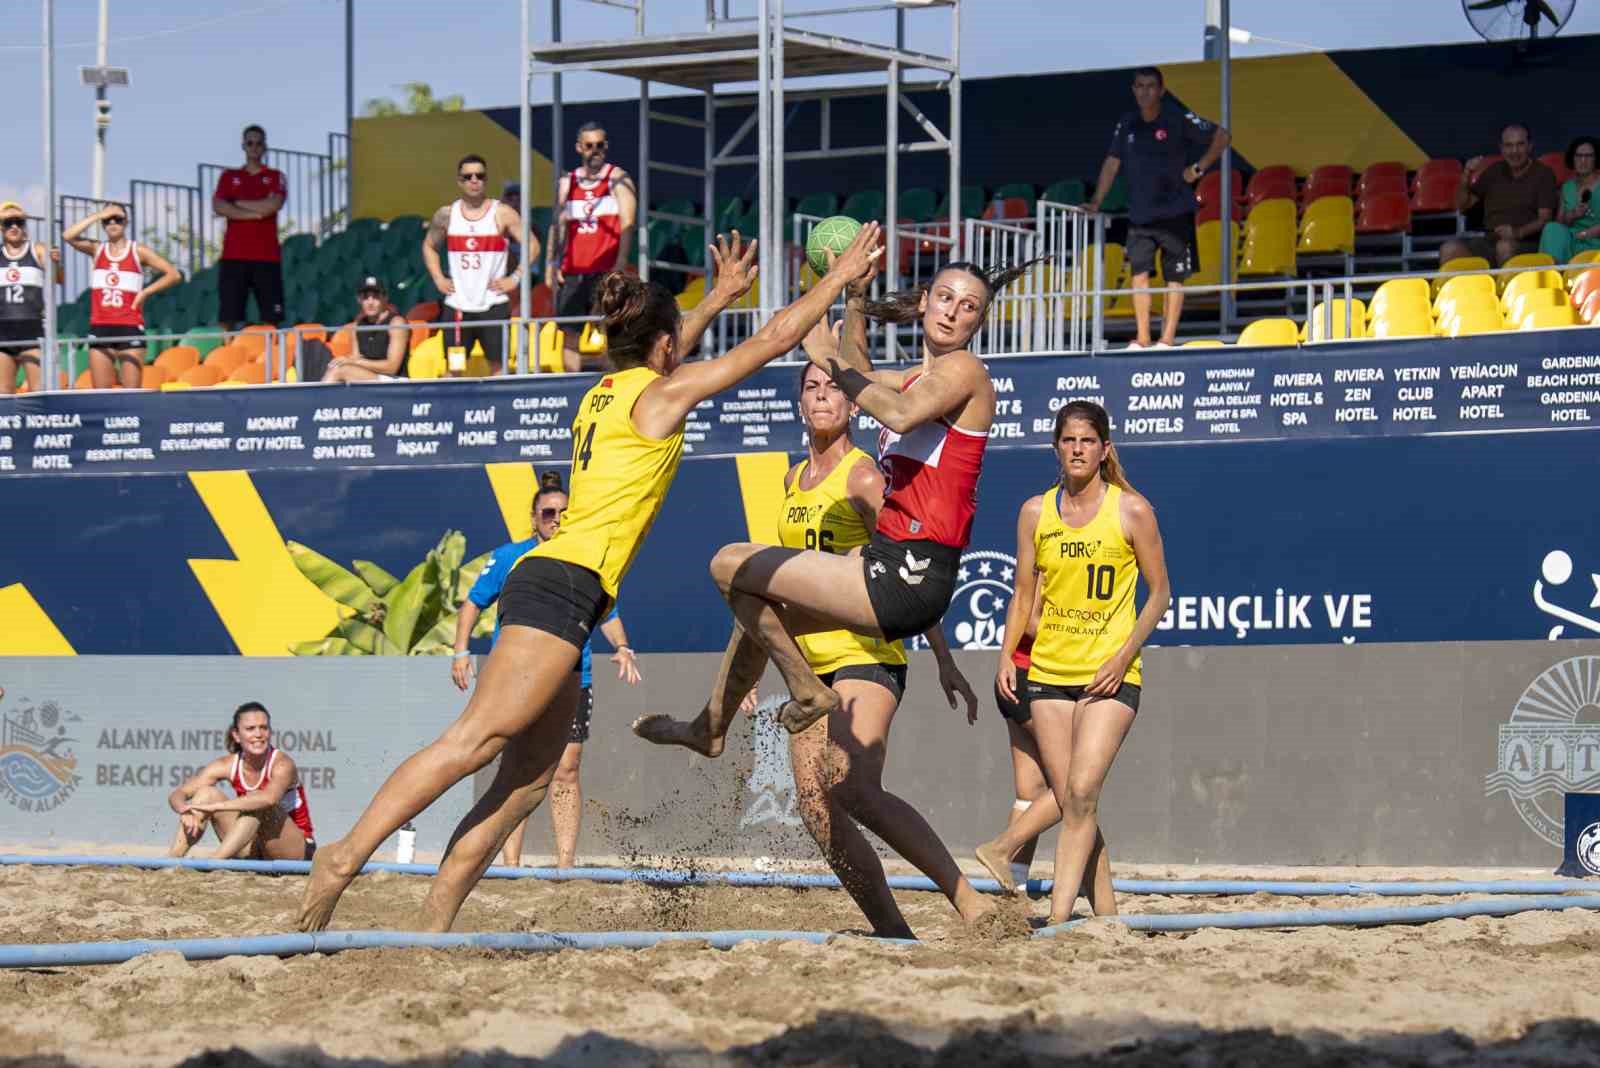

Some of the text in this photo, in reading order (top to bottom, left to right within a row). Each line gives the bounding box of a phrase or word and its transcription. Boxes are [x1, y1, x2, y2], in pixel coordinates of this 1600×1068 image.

[460, 253, 482, 271] 53
[5, 286, 25, 304] 12
[101, 290, 124, 309] 26
[1541, 355, 1600, 370] GARDENIA
[1131, 371, 1185, 388] GRAND
[1206, 368, 1255, 380] WYNDHAM
[1273, 373, 1323, 387] RIVIERA
[1334, 368, 1384, 382] RIVIERA
[1394, 367, 1441, 382] YETKIN
[1057, 376, 1100, 390] ROYAL
[1208, 382, 1244, 393] ALANYA
[1527, 375, 1568, 388] BEACH
[1344, 388, 1371, 402] ZEN
[1398, 387, 1434, 401] CLUB
[1461, 384, 1504, 399] APART
[1540, 390, 1600, 404] GARDENIA
[513, 396, 568, 410] CLUB AQUA
[1128, 394, 1184, 411] ZAMAN
[1193, 395, 1262, 407] AZURA DELUXE
[1270, 392, 1323, 407] HOTEL &
[313, 406, 383, 422] ASIA BEACH
[1195, 409, 1230, 420] RESORT
[1240, 408, 1257, 419] SPA
[1282, 412, 1307, 426] SPA
[1335, 407, 1379, 422] HOTEL
[1392, 407, 1437, 421] HOTEL
[1460, 405, 1504, 419] HOTEL
[1551, 409, 1590, 421] HOTEL
[26, 414, 82, 428] NOVELLA
[169, 422, 224, 434] BEST HOME
[247, 416, 298, 431] MONART
[1125, 417, 1184, 434] HOTELS
[318, 426, 363, 440] RESORT
[385, 422, 453, 436] ALPARSLAN
[540, 428, 572, 440] PLAZA
[988, 422, 1025, 438] OTEL
[1210, 423, 1240, 434] HOTEL
[34, 434, 73, 448] APART
[160, 438, 232, 451] DEVELOPMENT
[236, 436, 305, 451] CITY HOTEL
[458, 431, 498, 446] HOME
[123, 448, 155, 460] HOTEL
[313, 445, 375, 460] SPA HOTEL
[520, 444, 552, 456] HOTEL
[32, 455, 72, 469] HOTEL
[1086, 563, 1116, 601] 10
[1156, 588, 1373, 639] GENÇLİK VE
[97, 729, 337, 752] ALANYA INTEIONAL
[97, 764, 164, 787] BEACH
